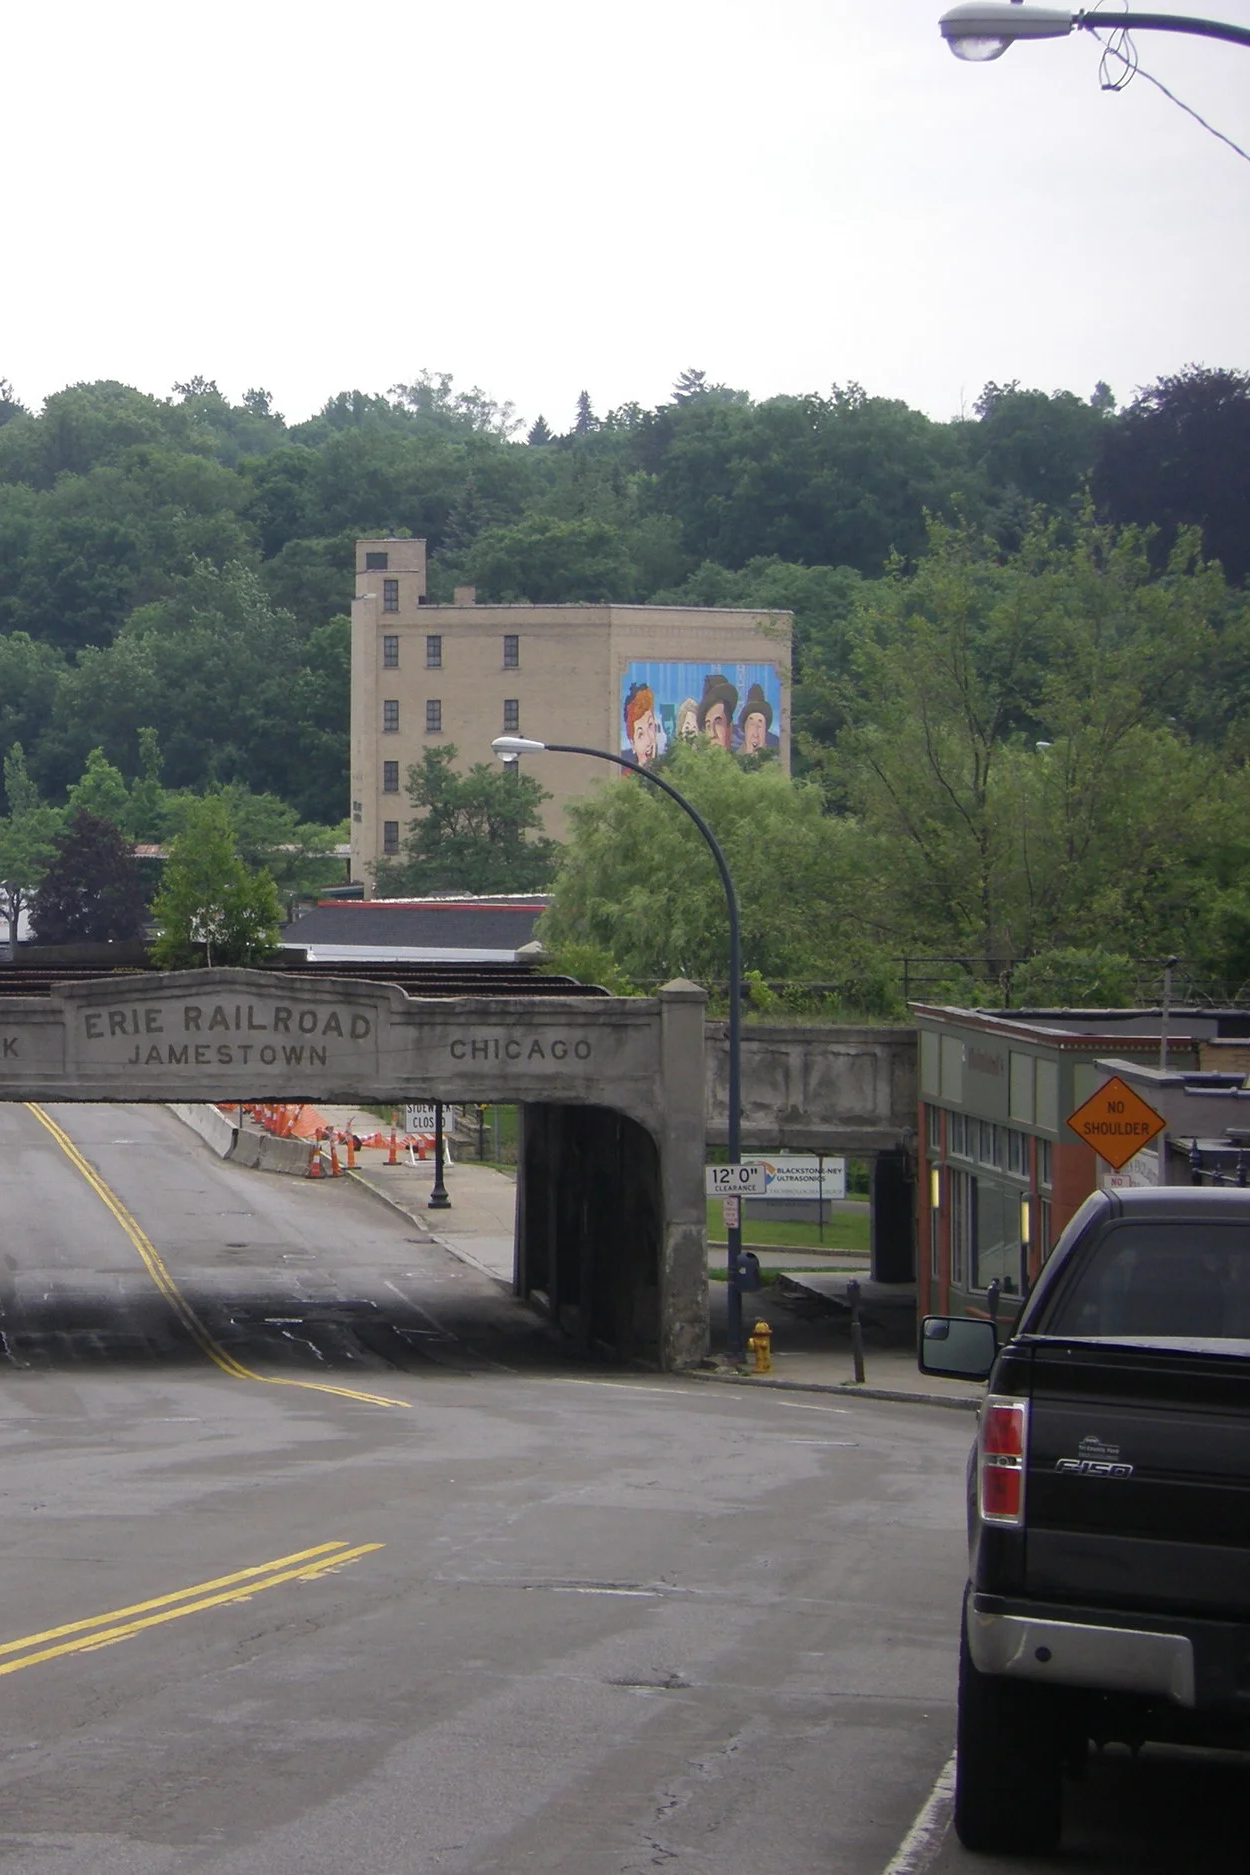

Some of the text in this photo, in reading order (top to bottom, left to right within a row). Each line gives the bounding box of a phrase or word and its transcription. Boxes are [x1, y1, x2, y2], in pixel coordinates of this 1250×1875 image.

[84, 1005, 371, 1040] ERIE RAILROAD
[127, 1043, 328, 1066] JAMESTOWN
[450, 1038, 591, 1060] CHICAGO
[1107, 1100, 1125, 1114] NO
[412, 1116, 446, 1128] CLOSD
[1083, 1122, 1150, 1135] SHOULDER
[713, 1168, 758, 1183] 12' 0"
[1110, 1177, 1123, 1186] NO
[715, 1184, 757, 1192] CLEARANCE
[1053, 1458, 1134, 1480] F-150
